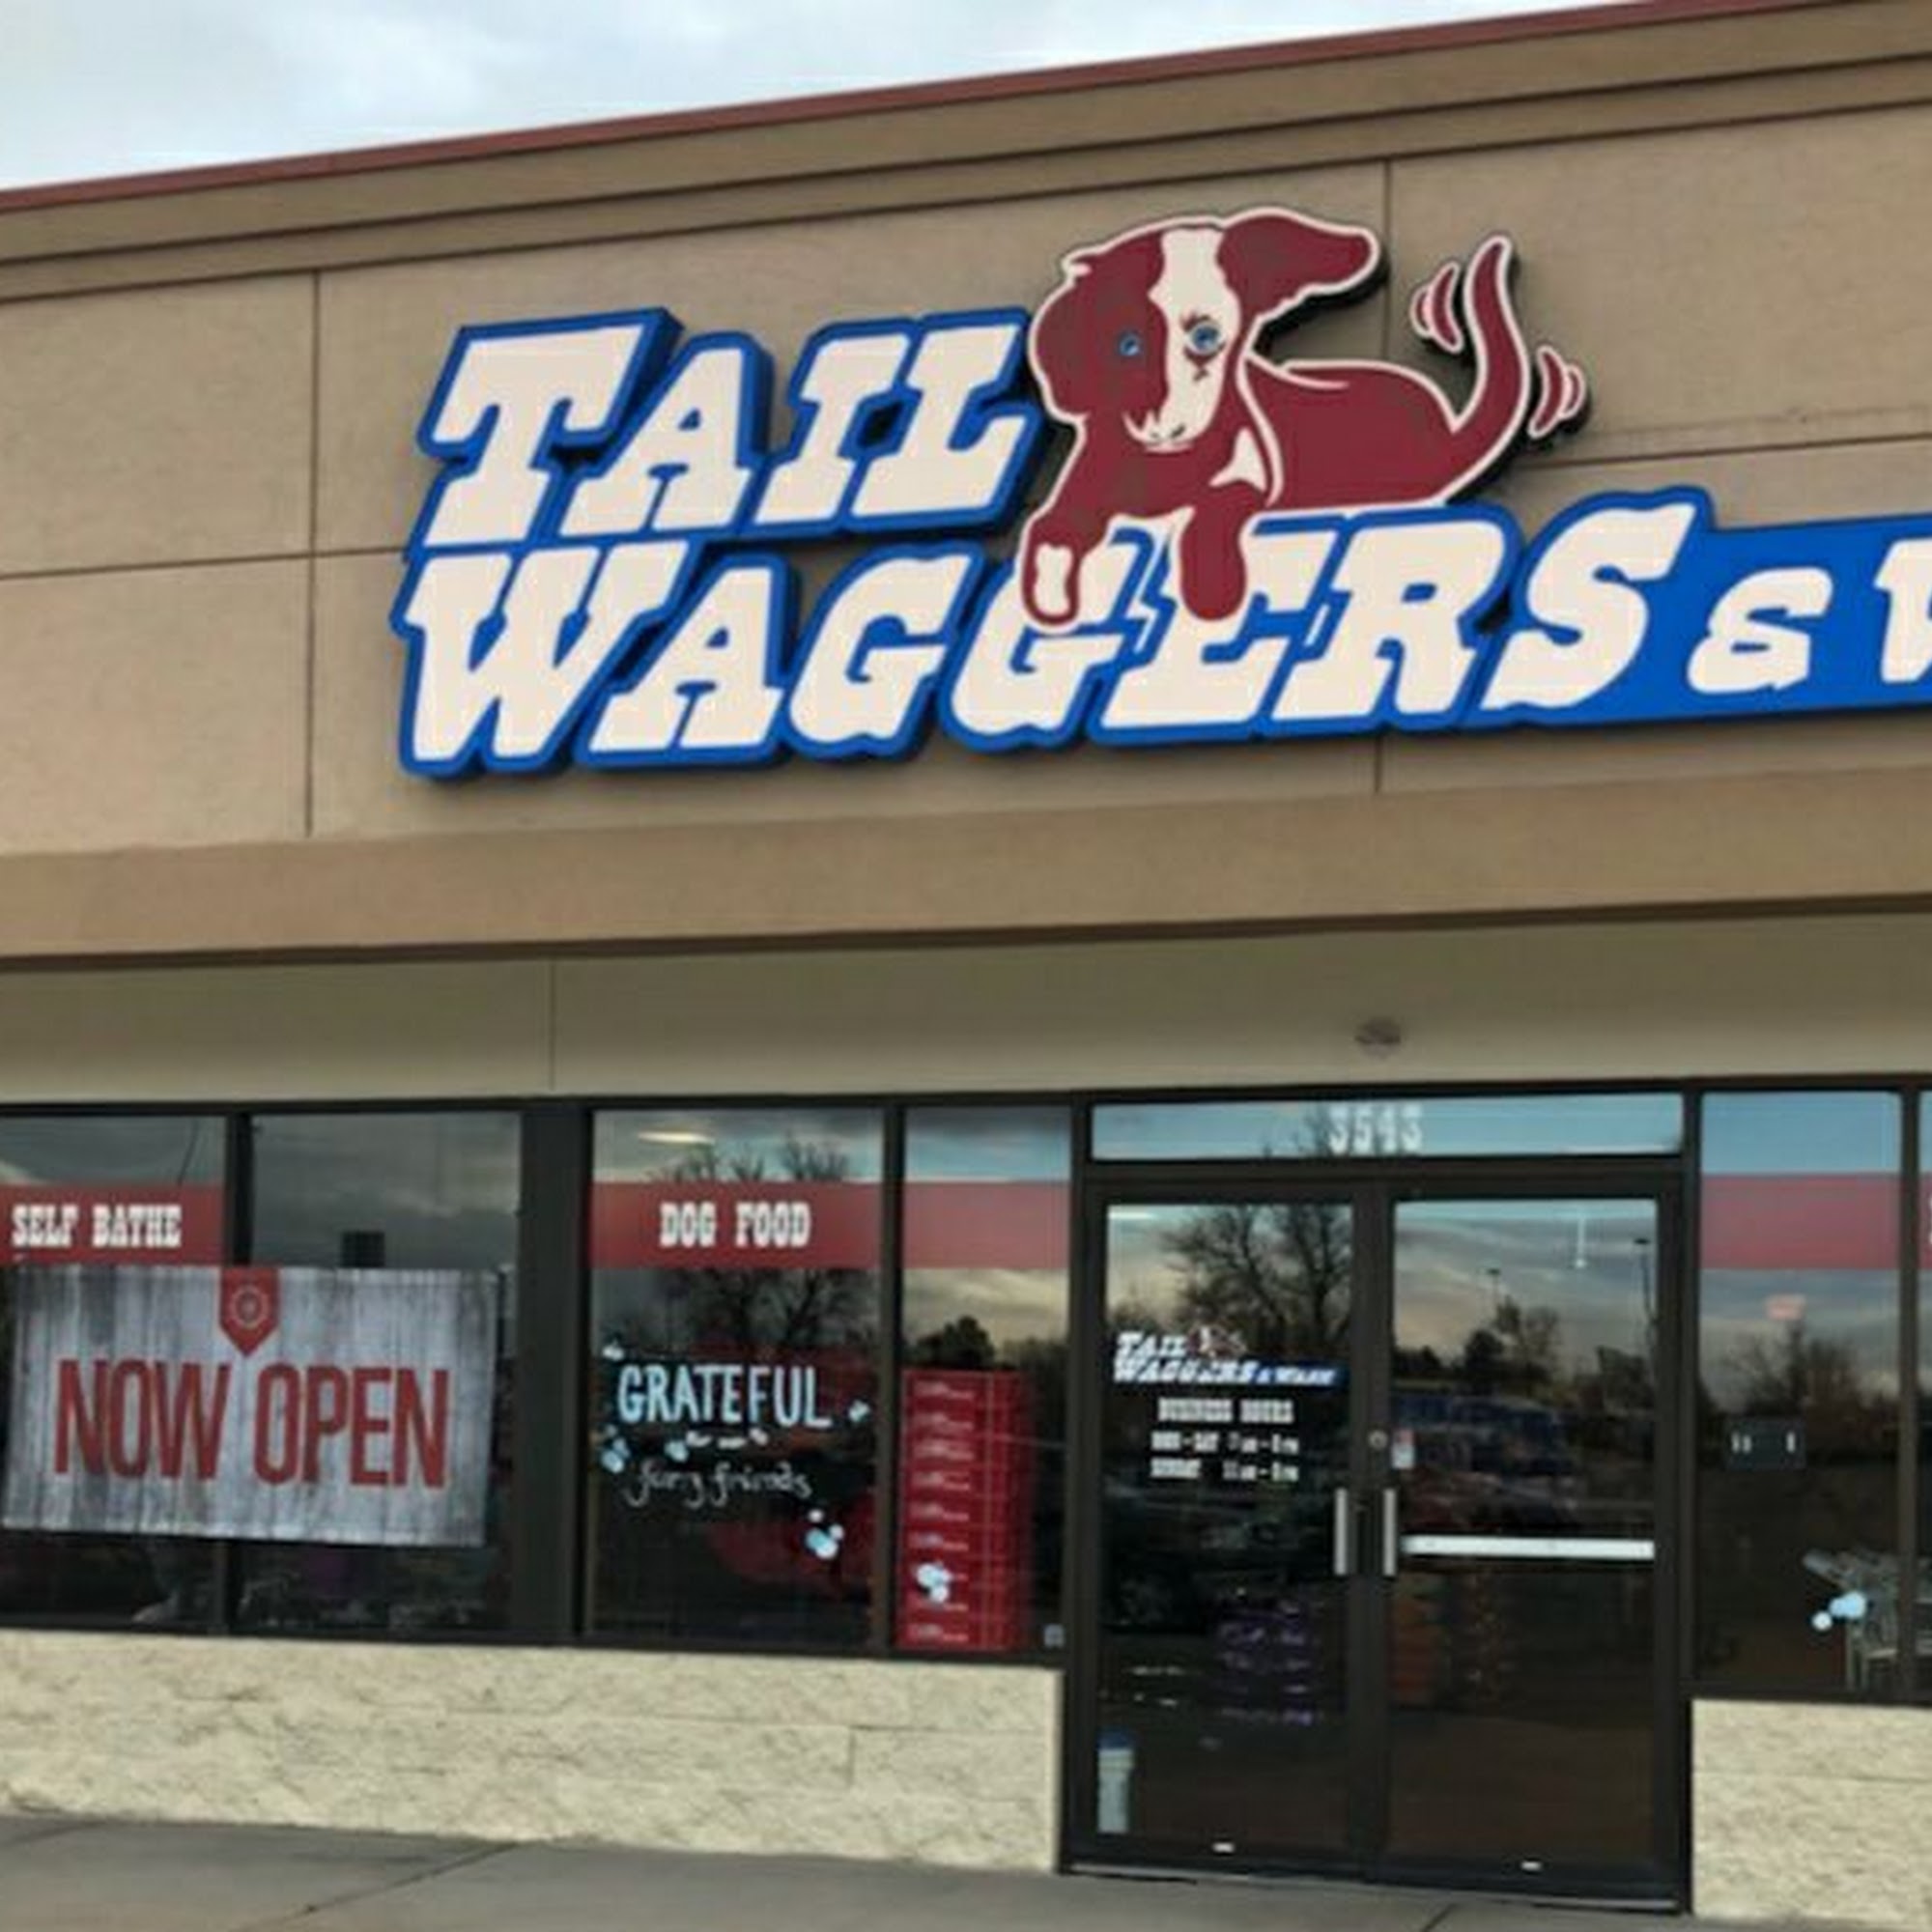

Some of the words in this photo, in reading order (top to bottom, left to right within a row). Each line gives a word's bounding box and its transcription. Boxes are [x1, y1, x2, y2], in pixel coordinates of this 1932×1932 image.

[432, 324, 1027, 547] TAIL
[403, 501, 1696, 761] WAGGERS
[1688, 566, 1833, 695] &
[12, 1205, 79, 1247] SELF
[92, 1205, 182, 1247] BATHE
[660, 1202, 716, 1247] DOG
[736, 1202, 810, 1247] FOOD
[55, 1359, 232, 1480] NOW
[253, 1363, 449, 1488] OPEN
[617, 1363, 833, 1427] GRATEFUL
